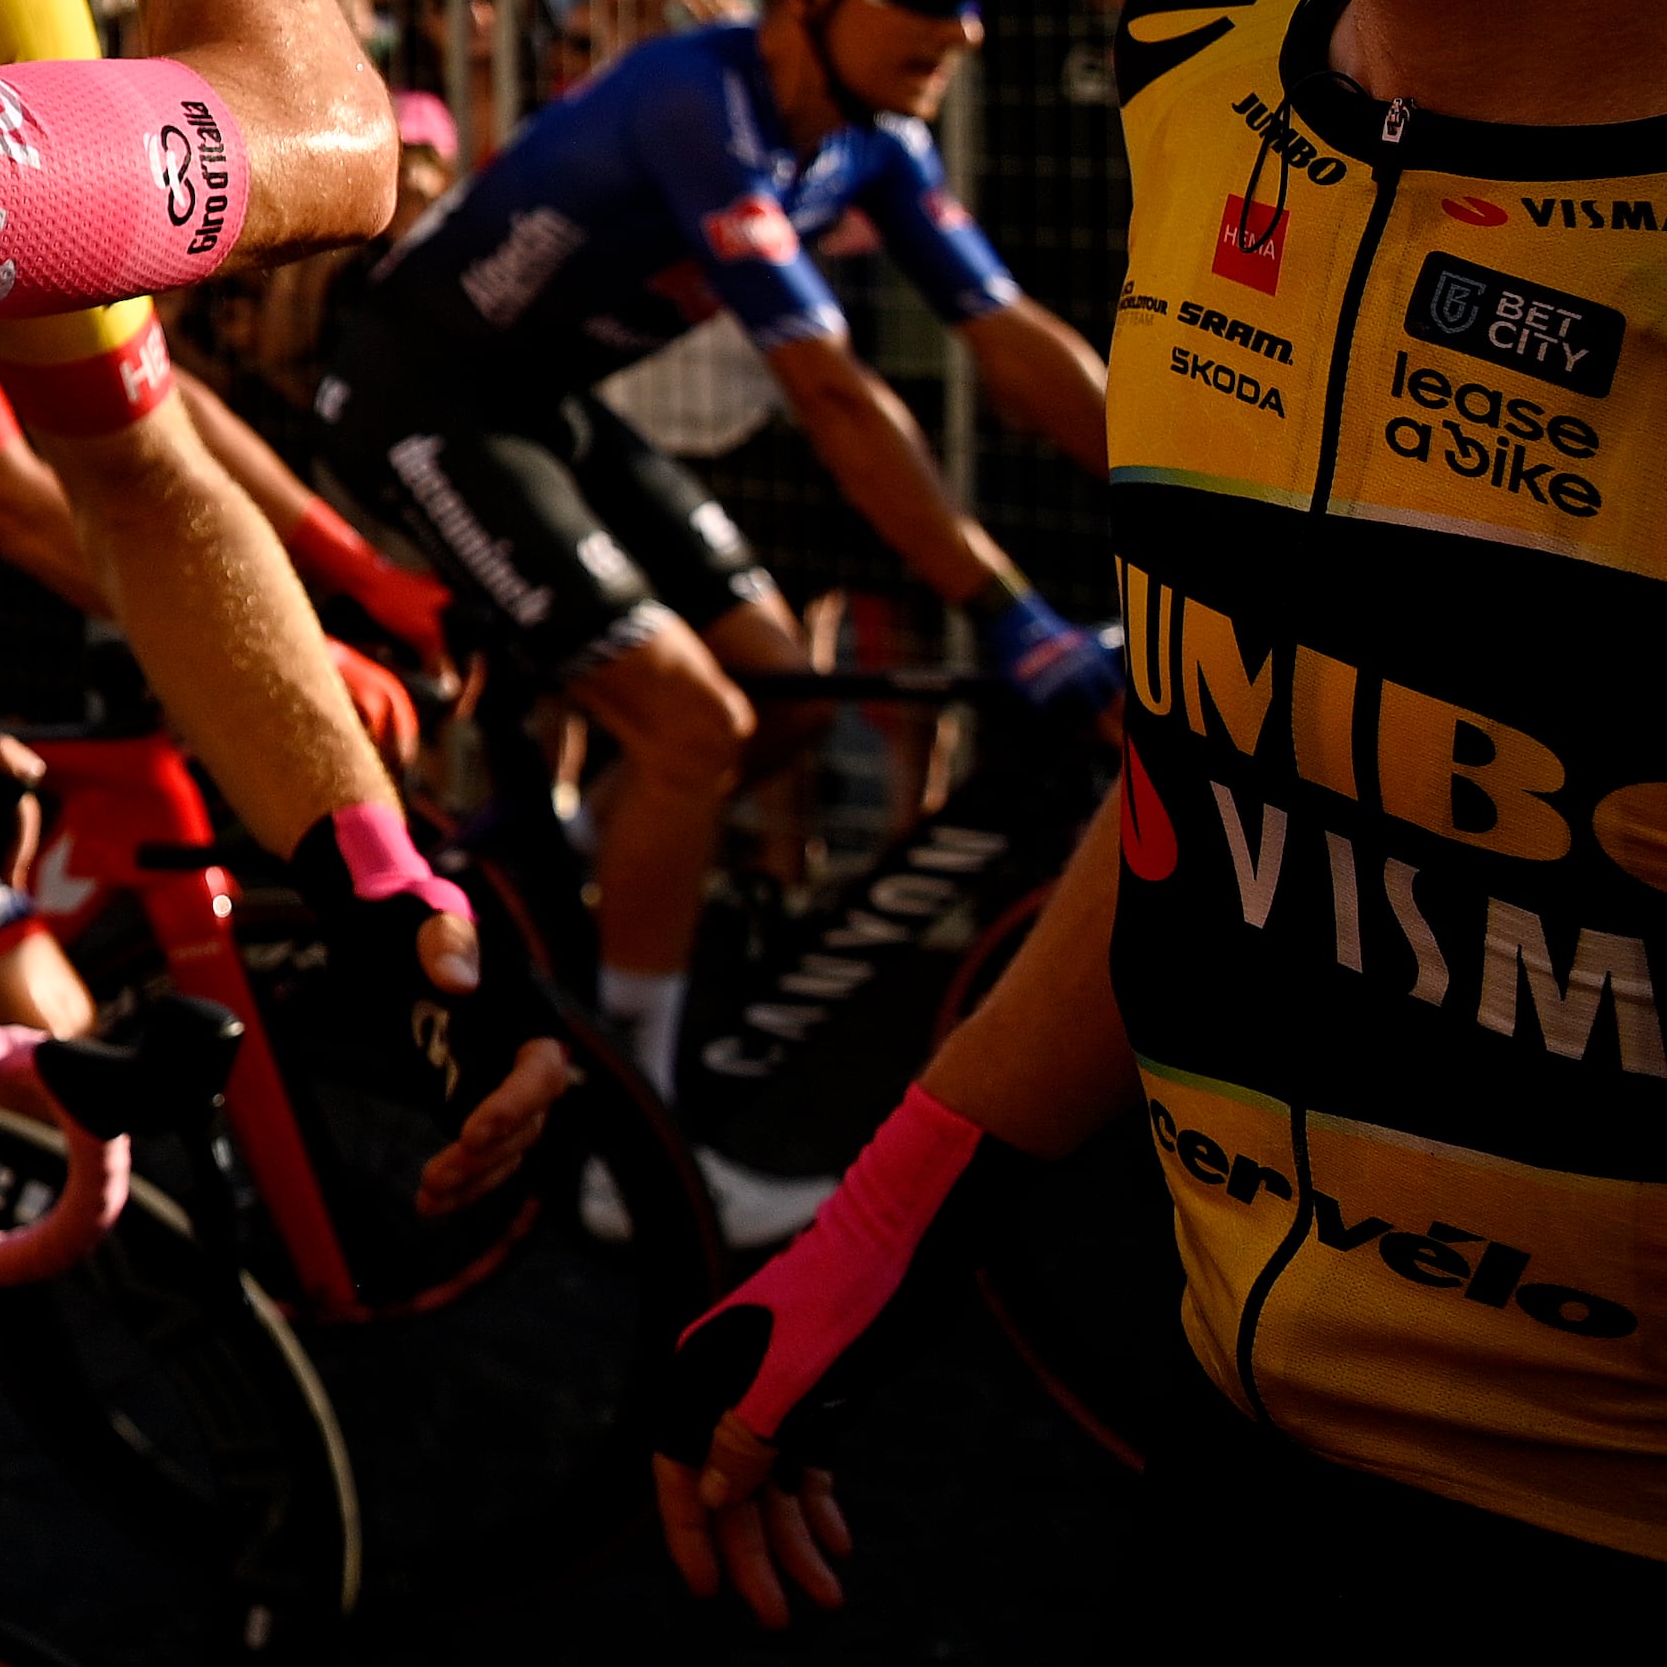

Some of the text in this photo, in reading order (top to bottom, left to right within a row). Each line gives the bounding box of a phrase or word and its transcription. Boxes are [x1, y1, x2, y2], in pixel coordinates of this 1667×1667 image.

[1231, 92, 1348, 186] JUMBO
[1488, 323, 1591, 373] CITY
[1495, 289, 1584, 338] BET
[1391, 349, 1601, 459] lease
[1115, 554, 1667, 892] UMB
[1210, 781, 1667, 1078] VISM
[1151, 1098, 1639, 1338] cervélo
